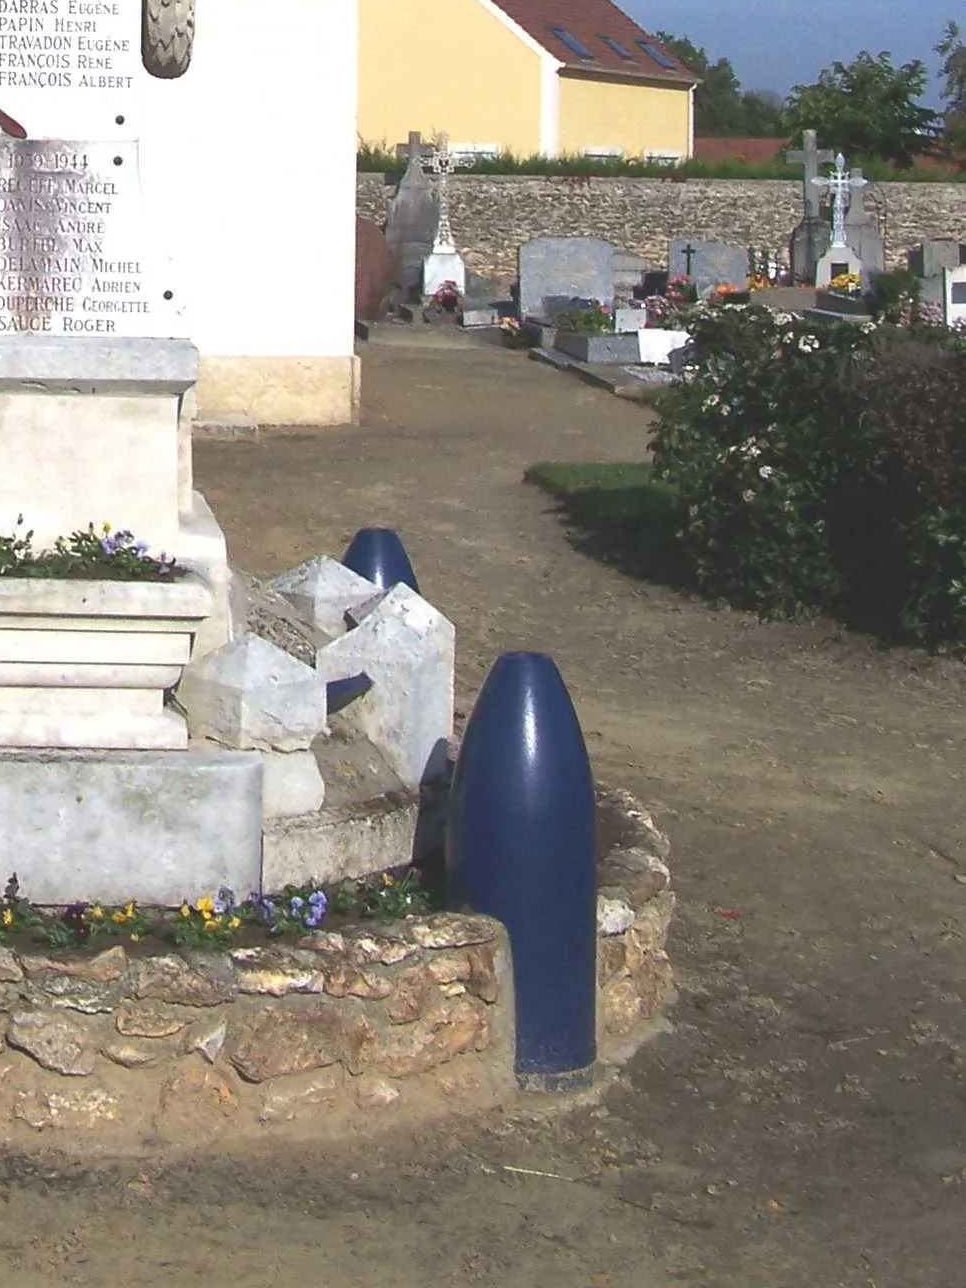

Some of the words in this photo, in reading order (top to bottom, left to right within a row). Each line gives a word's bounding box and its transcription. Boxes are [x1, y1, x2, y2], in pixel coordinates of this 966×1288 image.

[55, 17, 97, 33] HENRI
[78, 74, 133, 88] ALBERT
[64, 178, 118, 195] MARCEL
[73, 238, 103, 254] MAX
[92, 257, 142, 273] MICHEL
[91, 277, 141, 293] ADRIEN
[82, 296, 151, 313] GEORGETTE
[63, 316, 116, 332] ROGER
